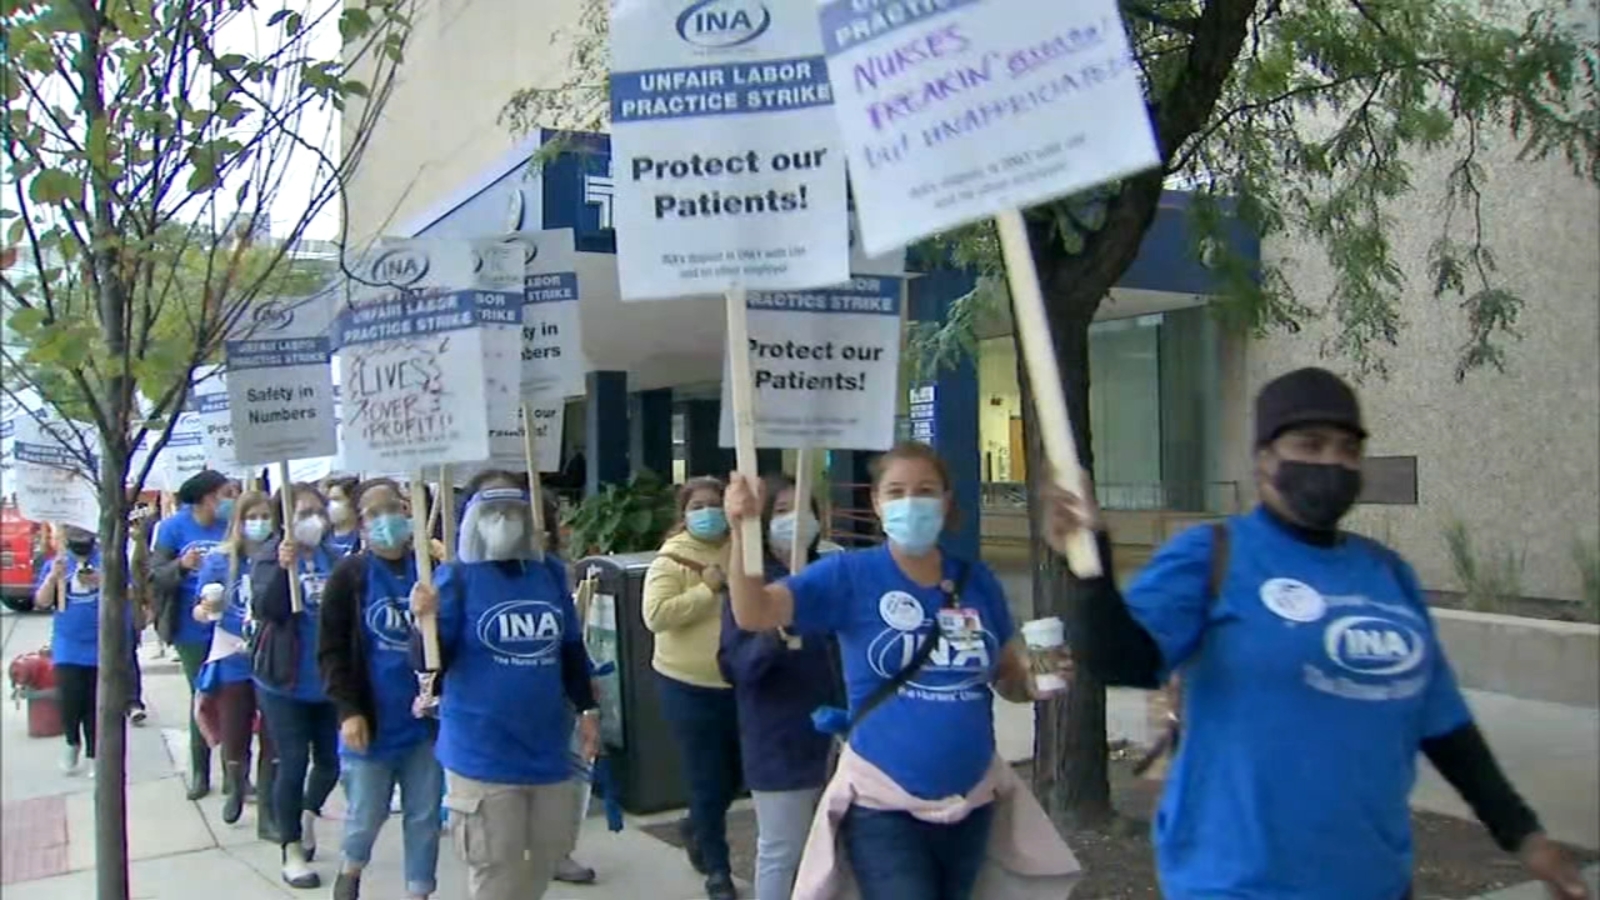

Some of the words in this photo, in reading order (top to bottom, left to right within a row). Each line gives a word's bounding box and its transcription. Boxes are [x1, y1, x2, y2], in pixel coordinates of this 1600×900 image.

[695, 10, 752, 33] INA
[640, 69, 725, 92] UNFAIR
[733, 62, 811, 85] LABOR
[621, 92, 738, 118] PRACTICE
[746, 83, 832, 108] STRIKE
[631, 150, 760, 181] Protect
[771, 148, 827, 172] our
[654, 185, 808, 219] Patients!
[383, 259, 418, 280] INA
[830, 296, 893, 311] STRIKE
[343, 319, 412, 343] PRACTICE
[416, 311, 472, 331] STRIKE
[842, 344, 884, 361] our
[755, 370, 866, 391] Patients!
[246, 387, 294, 403] Safety
[299, 387, 314, 398] in
[249, 408, 316, 424] Numbers
[534, 409, 556, 418] our
[499, 611, 560, 641] INA
[901, 634, 991, 668] INA
[1344, 628, 1411, 658] INA
